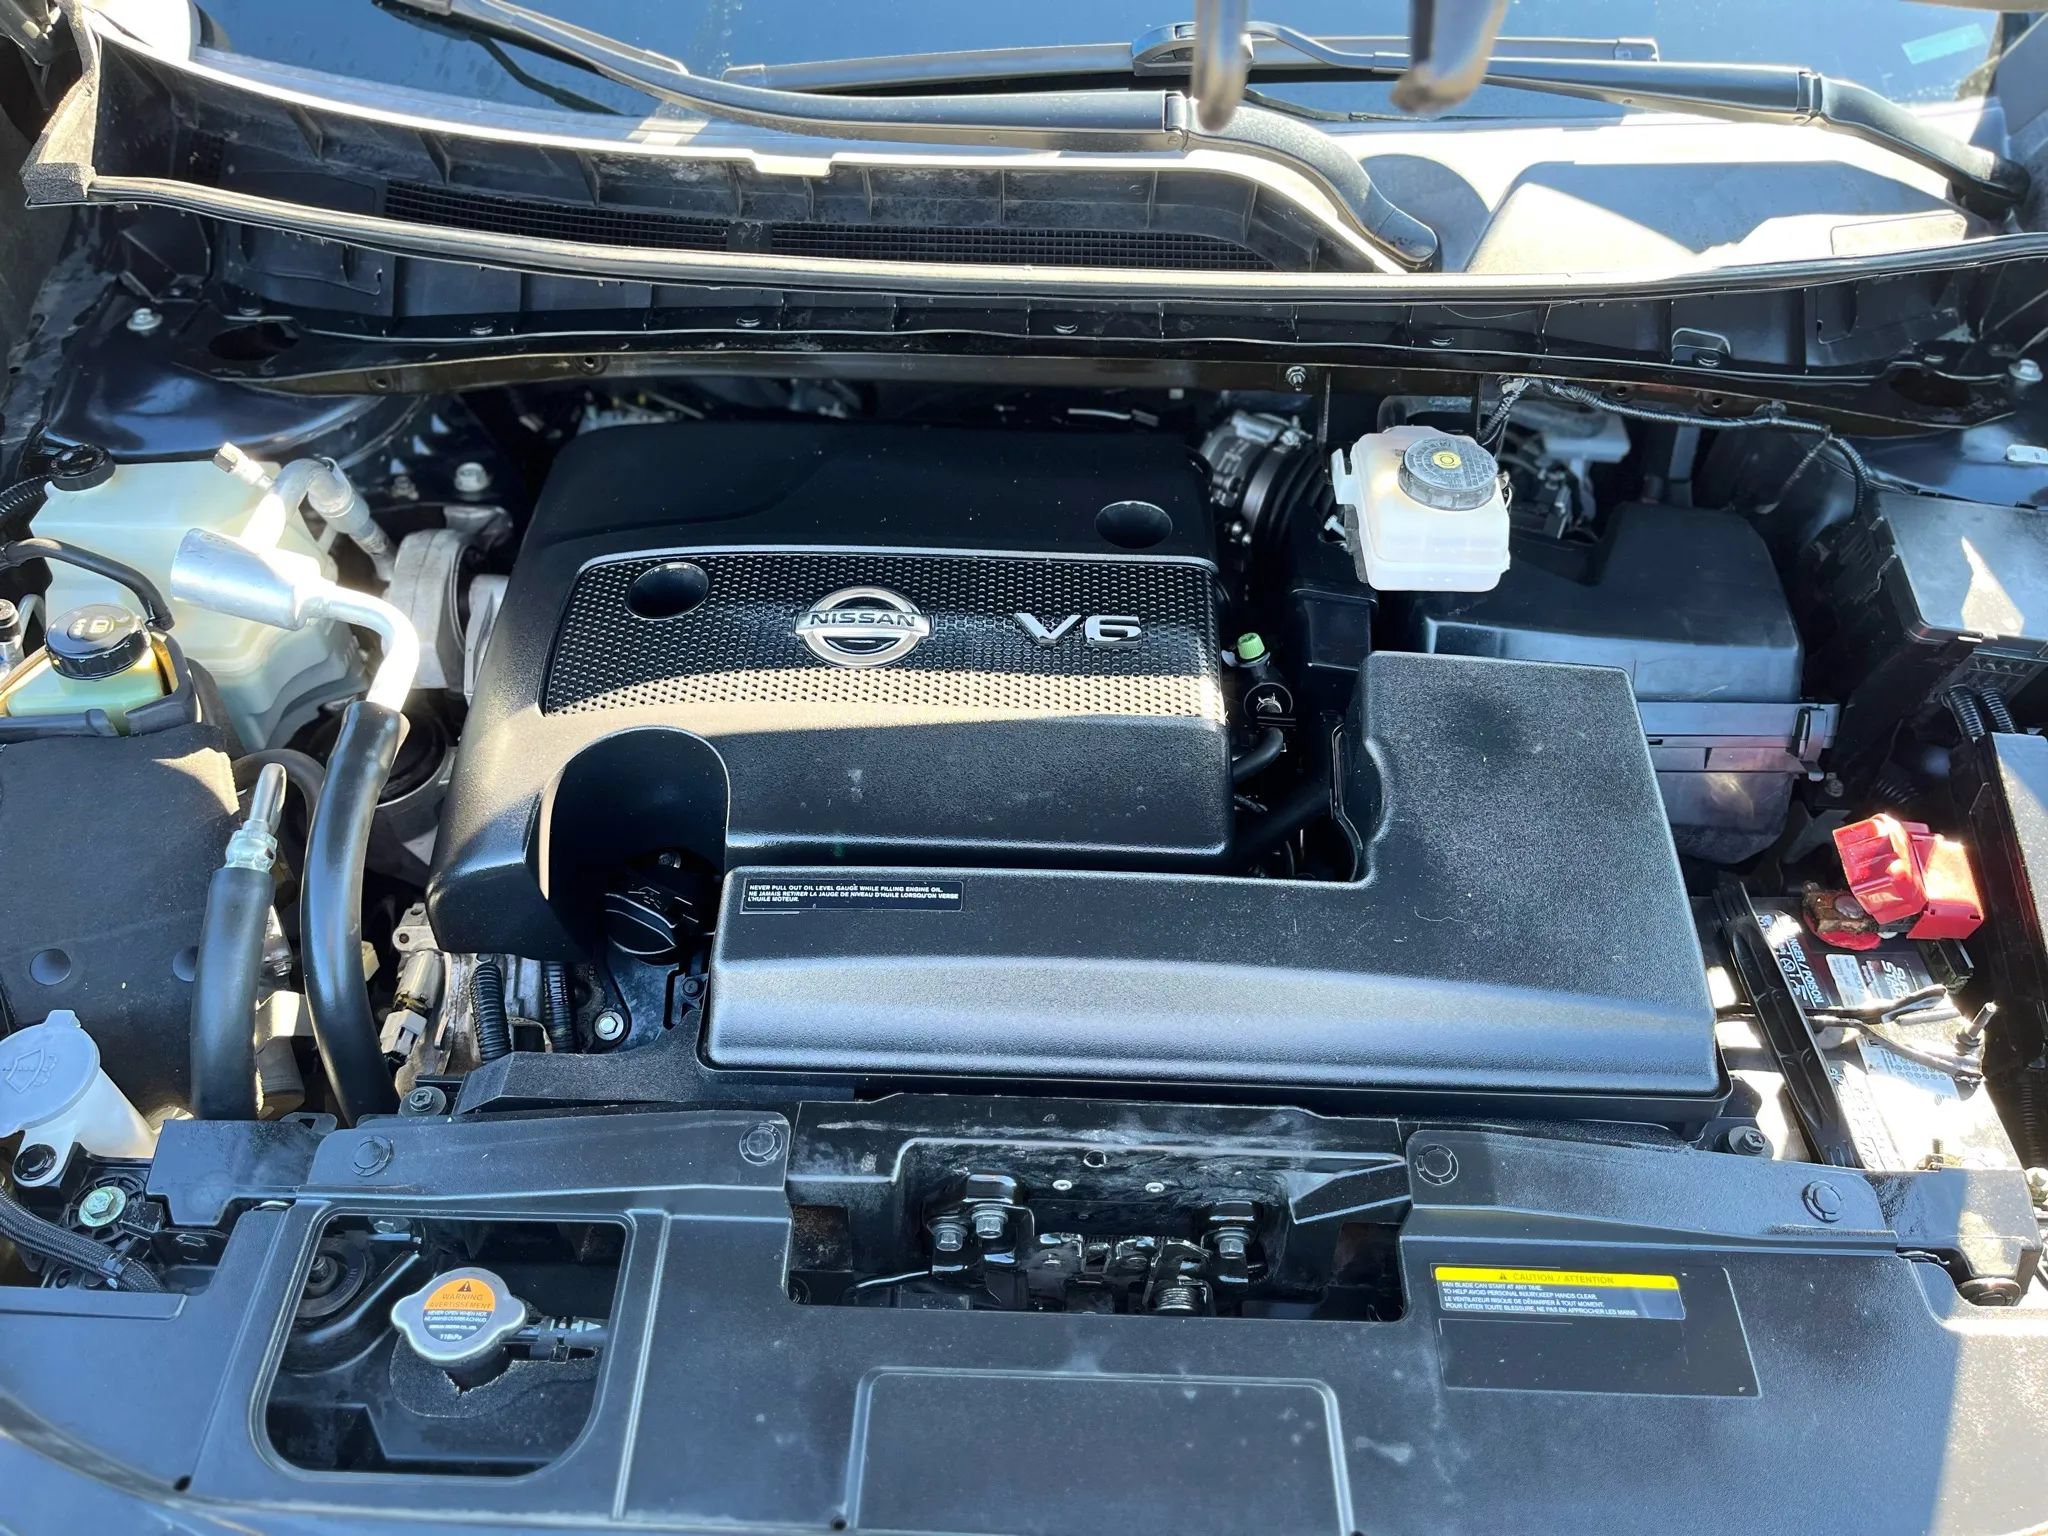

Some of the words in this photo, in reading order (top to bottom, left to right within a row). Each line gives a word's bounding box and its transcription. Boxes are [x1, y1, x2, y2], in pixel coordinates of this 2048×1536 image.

[810, 612, 915, 627] NISSAN
[1013, 613, 1141, 647] V6
[1802, 969, 1825, 1004] POISON
[1513, 1273, 1553, 1281] CAUTION
[1564, 1275, 1614, 1284] ATTENTION
[442, 1293, 484, 1301] WARNING
[429, 1301, 493, 1309] AVERTISSEMENT
